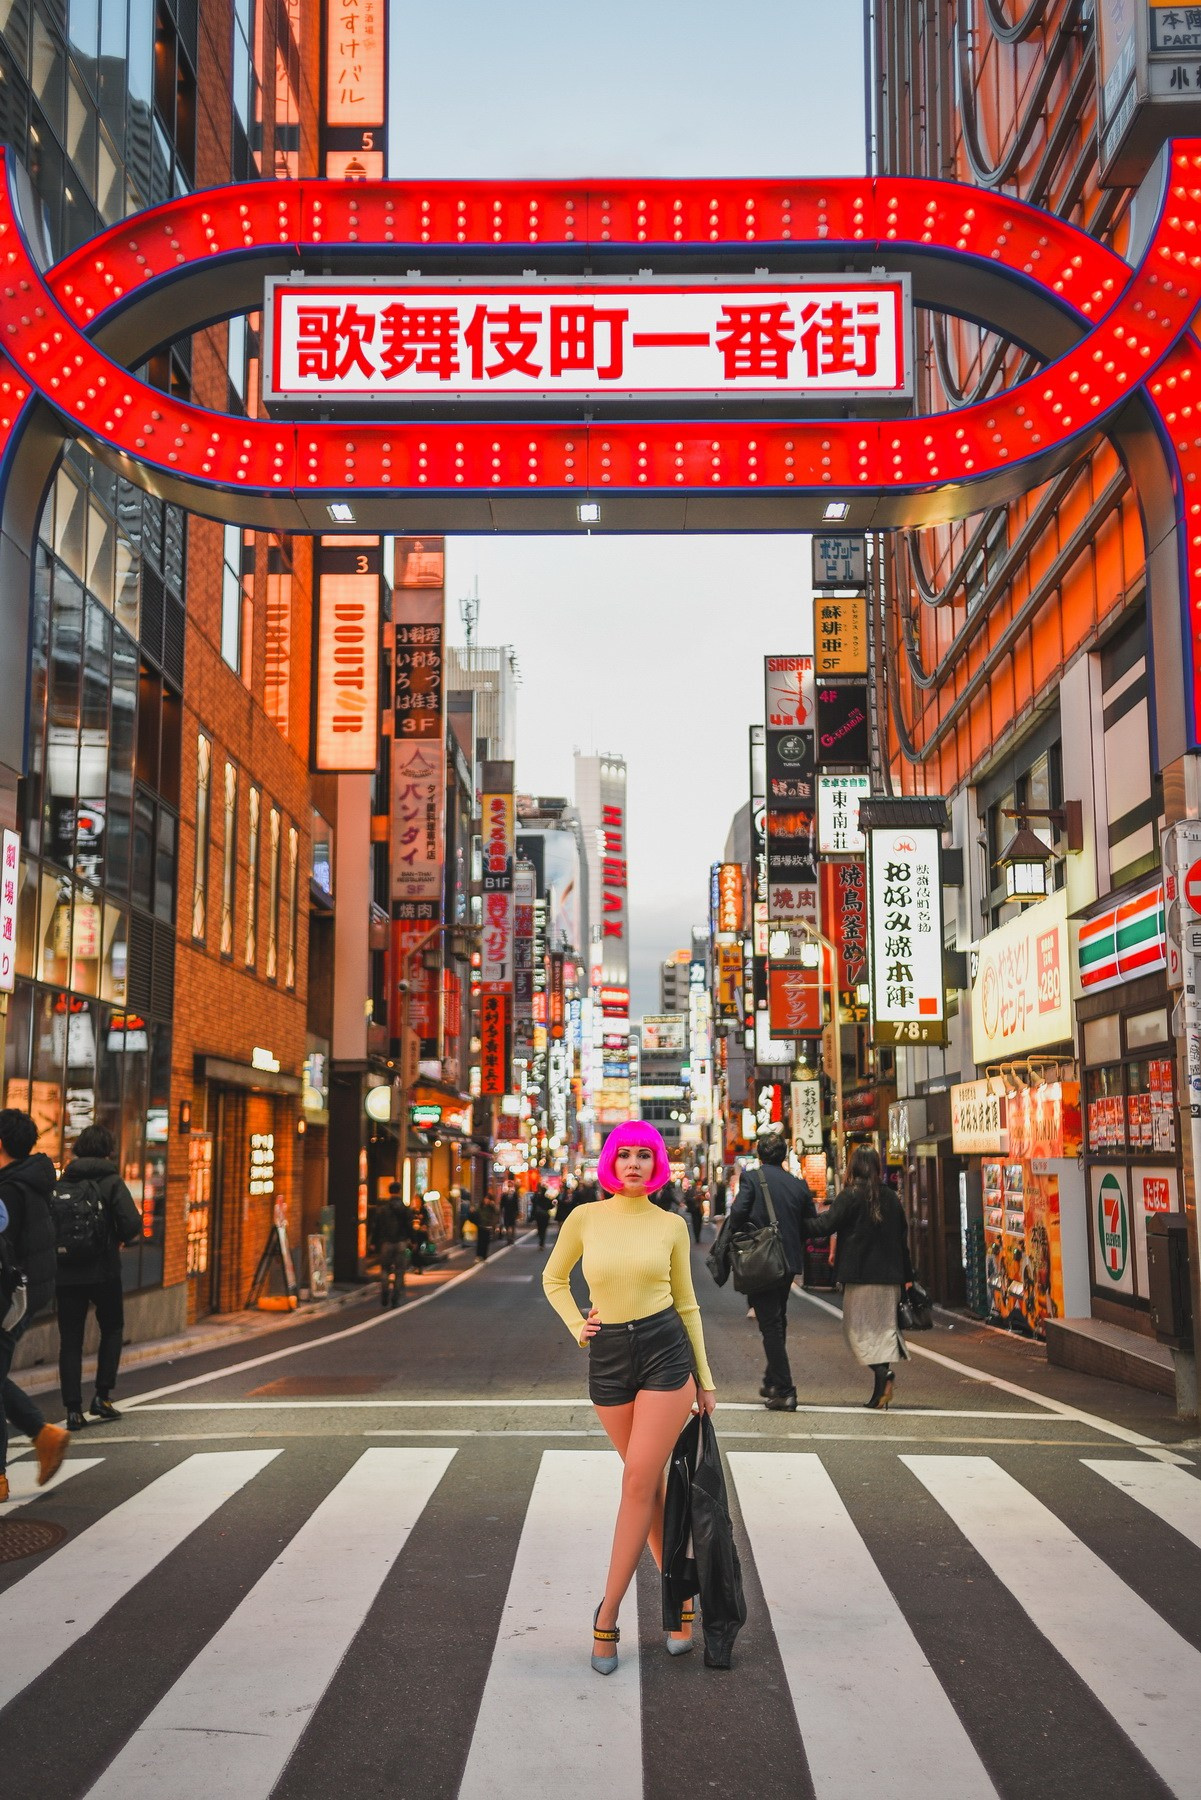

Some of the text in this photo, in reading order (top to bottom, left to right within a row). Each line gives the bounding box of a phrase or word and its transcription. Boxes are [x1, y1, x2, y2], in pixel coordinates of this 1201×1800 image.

[1163, 34, 1200, 45] PART
[1170, 65, 1201, 90] 小
[361, 132, 374, 150] 5
[297, 303, 881, 382] 歌舞伎町一番街
[355, 555, 367, 573] 3
[825, 560, 854, 580] ビル
[397, 626, 440, 643] 小料理
[332, 603, 364, 732] DOUTOR
[768, 658, 813, 672] SHISHA
[821, 659, 842, 668] 5F
[396, 653, 411, 709] いろは
[426, 651, 440, 709] あづま
[819, 691, 837, 702] 4F
[400, 718, 434, 732] 3F
[398, 785, 422, 866] バンタイ
[831, 790, 849, 850] 東南荘
[485, 878, 510, 888] B1F
[773, 889, 815, 909] 焼肉
[2, 844, 16, 975] 劇場通り
[399, 903, 432, 918] 焼肉
[883, 861, 913, 1008] お好み焼本陣
[783, 972, 808, 1027] ステップ
[1145, 1181, 1167, 1209] たばこ
